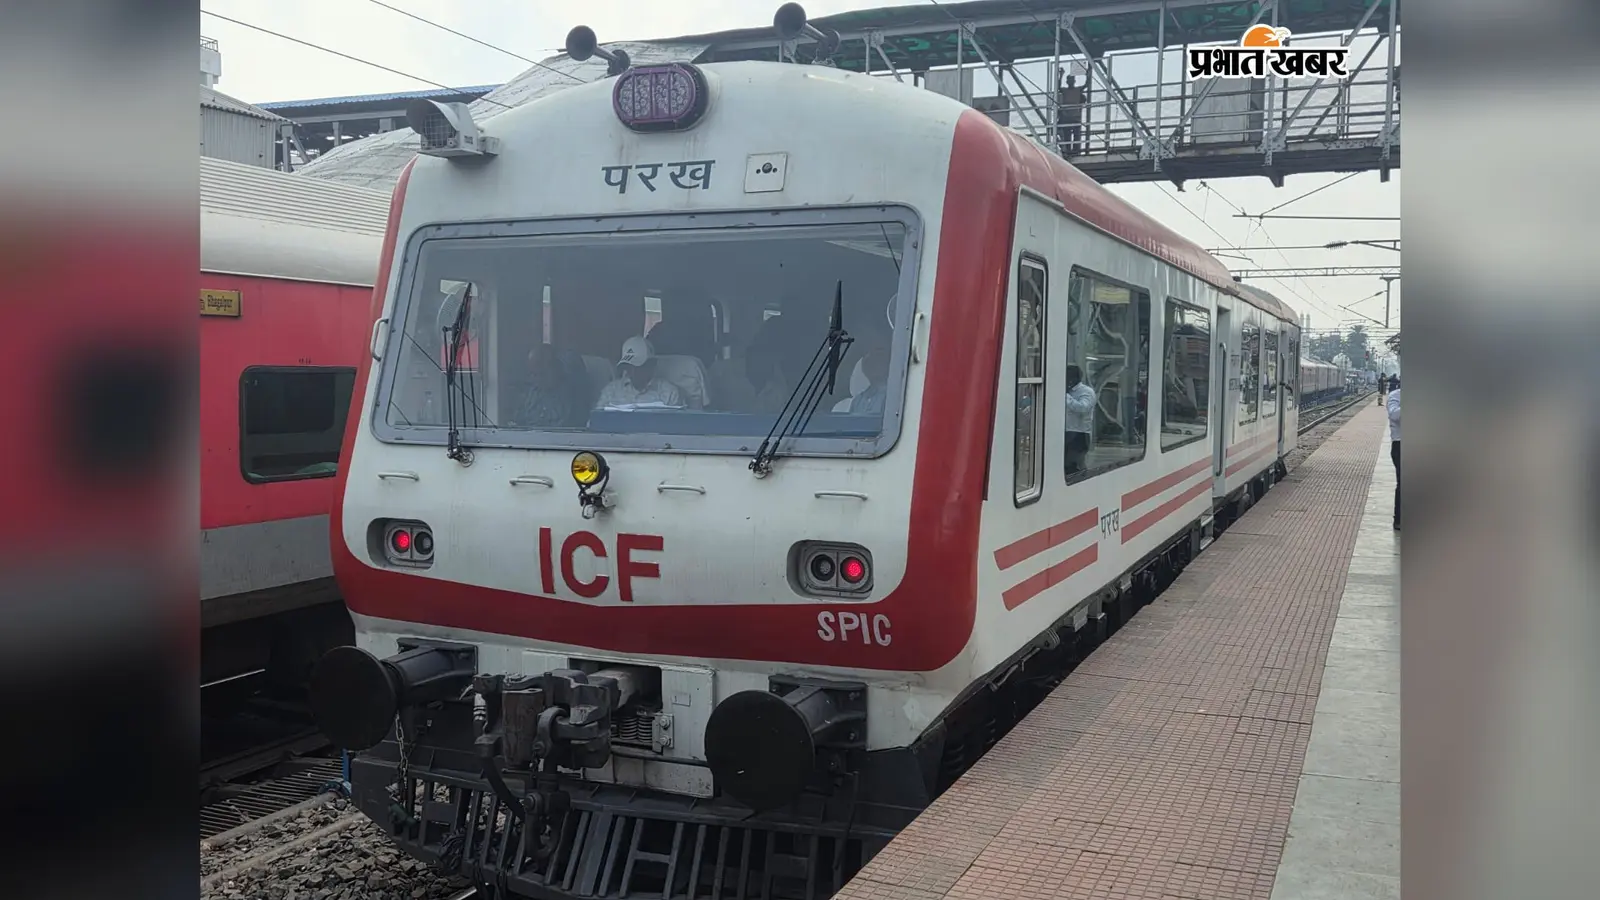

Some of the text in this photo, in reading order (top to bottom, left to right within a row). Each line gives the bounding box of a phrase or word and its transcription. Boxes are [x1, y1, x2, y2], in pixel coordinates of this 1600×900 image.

[602, 160, 715, 194] परख
[539, 526, 664, 602] ICF
[817, 611, 892, 646] SPIC
